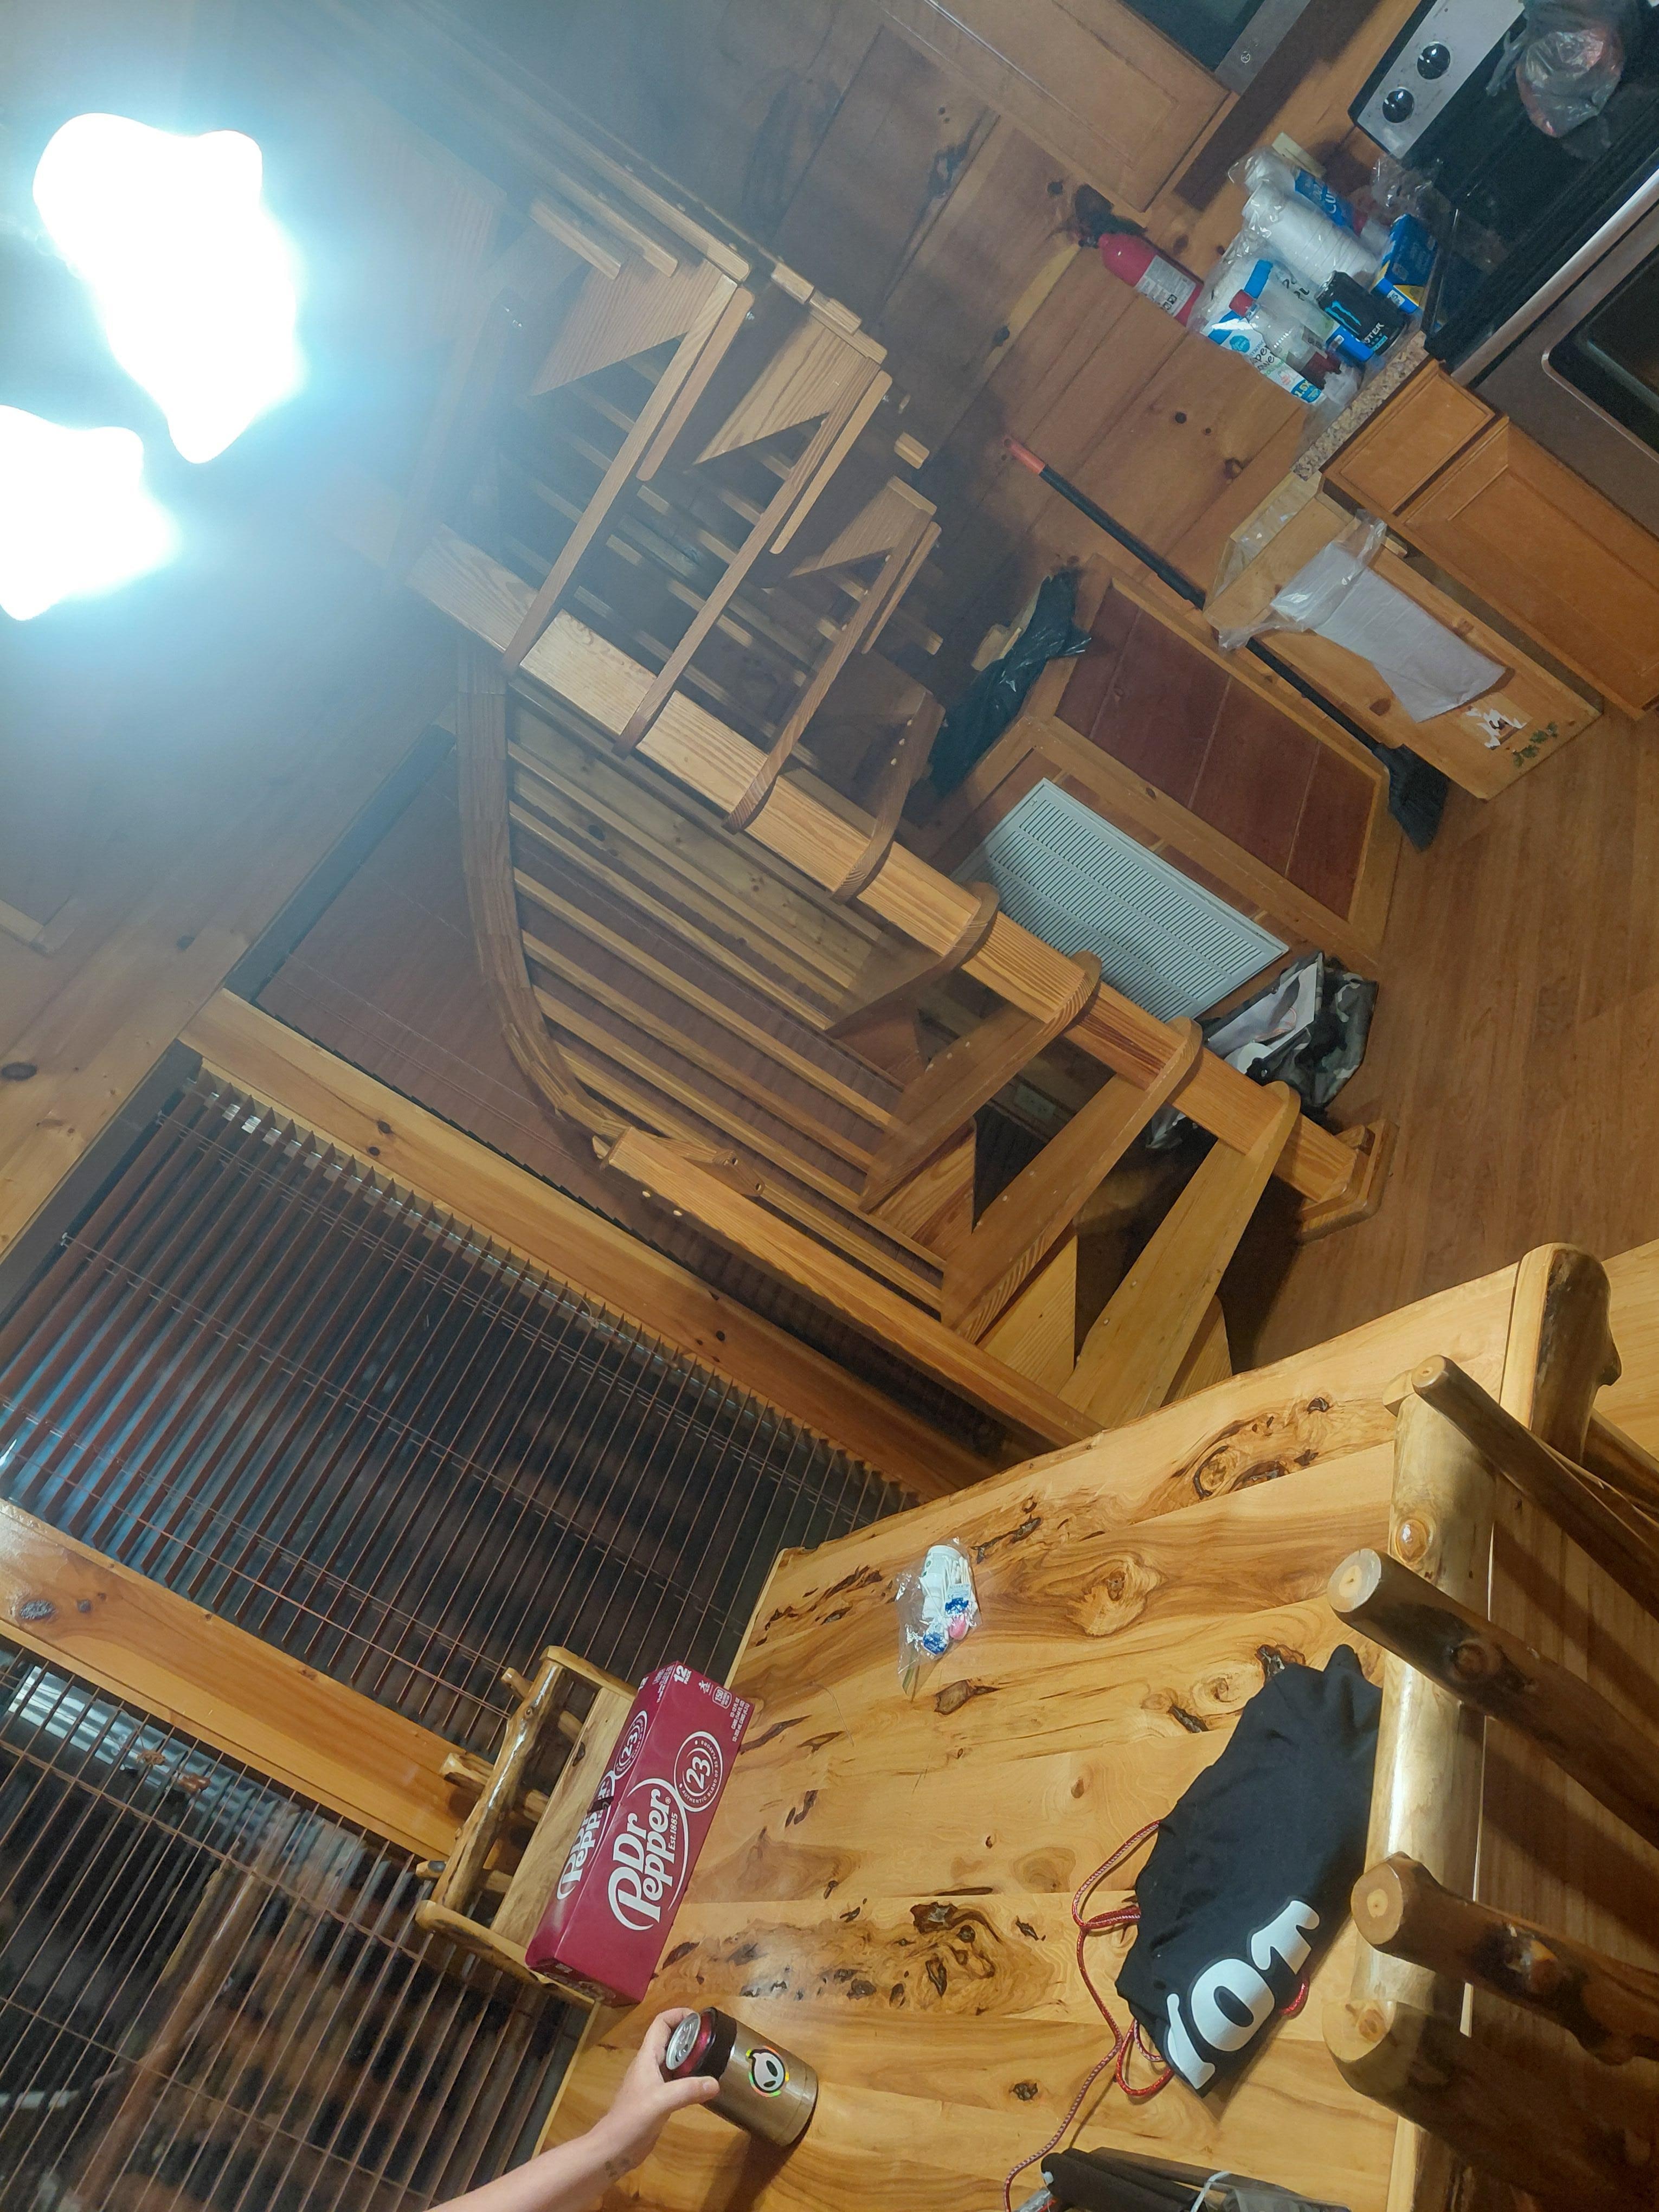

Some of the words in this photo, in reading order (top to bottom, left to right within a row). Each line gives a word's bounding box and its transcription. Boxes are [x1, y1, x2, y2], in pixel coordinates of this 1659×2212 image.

[673, 1665, 688, 1683] 12
[715, 1689, 724, 1702] 150
[621, 1732, 638, 1758] 23
[701, 1740, 717, 1760] FLAVORS
[686, 1756, 710, 1790] 23
[714, 1770, 719, 1778] OF
[681, 1790, 708, 1804] AUTHENTIC
[706, 1779, 717, 1797] BLEND
[613, 1812, 647, 1874] Dr
[608, 1789, 675, 1931] Pepper
